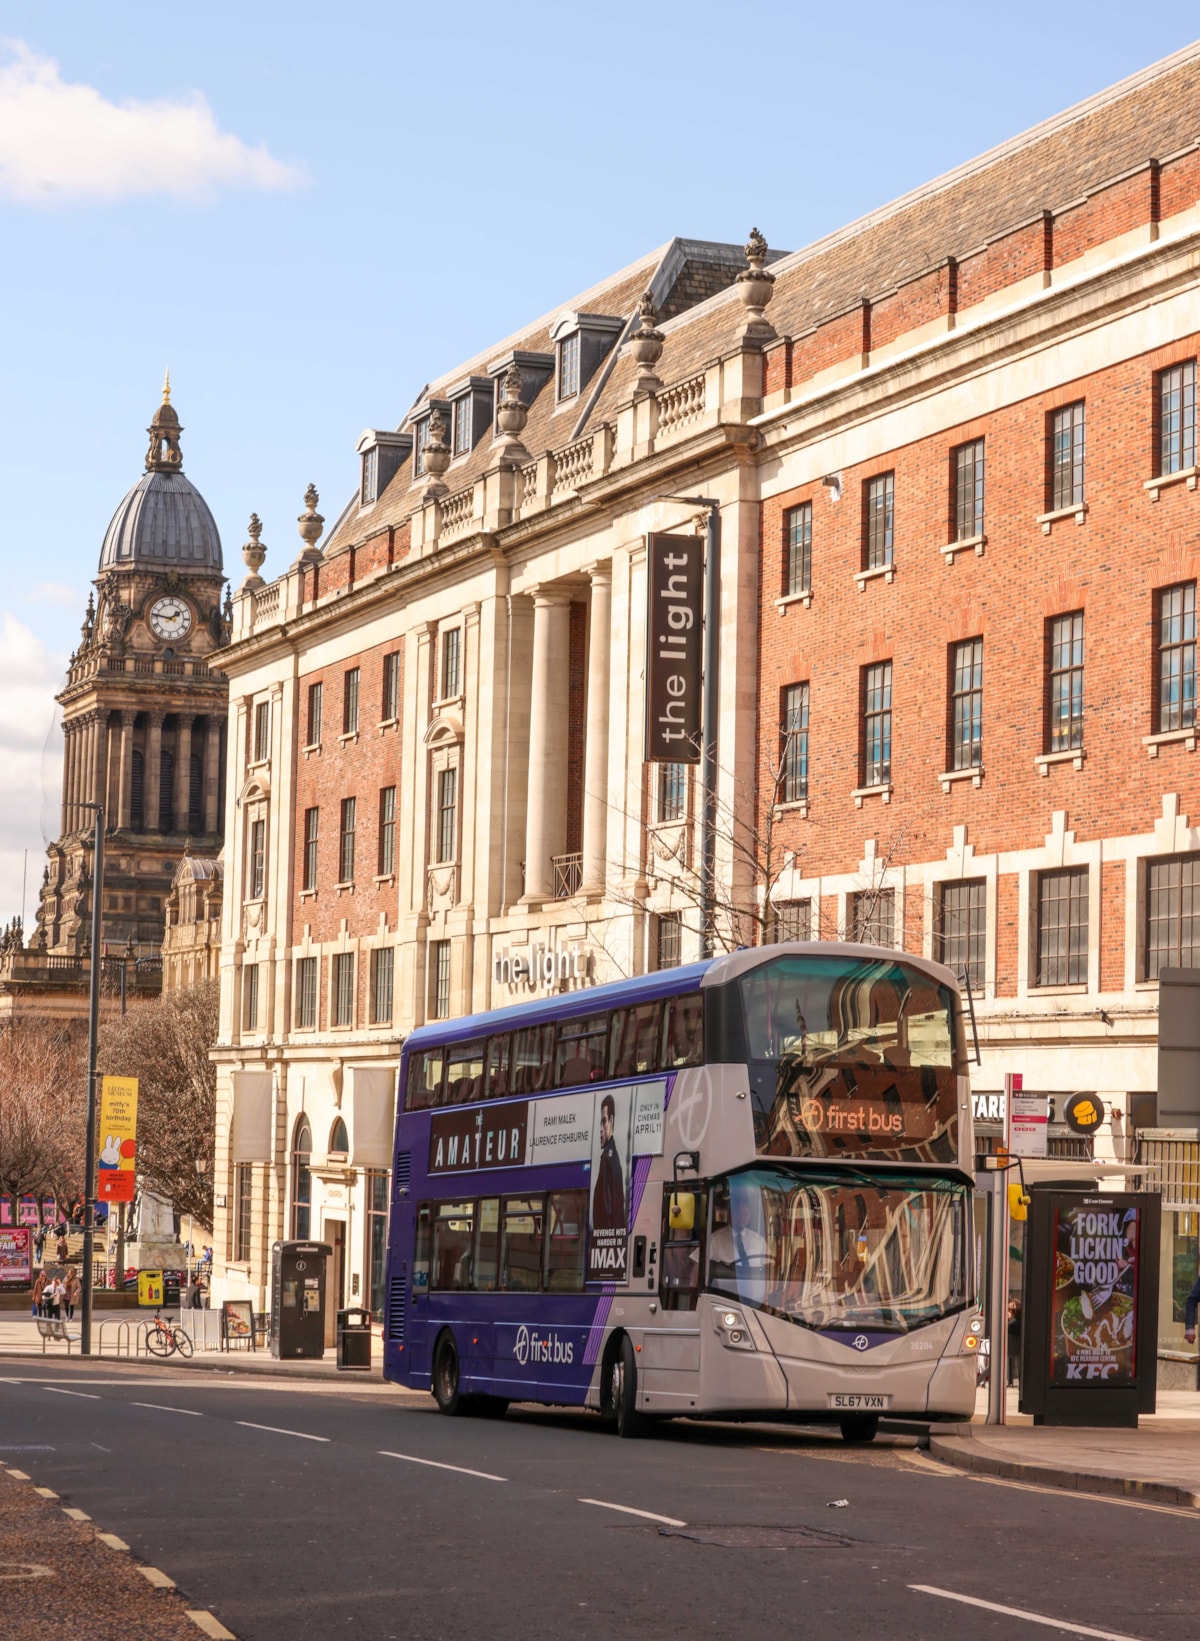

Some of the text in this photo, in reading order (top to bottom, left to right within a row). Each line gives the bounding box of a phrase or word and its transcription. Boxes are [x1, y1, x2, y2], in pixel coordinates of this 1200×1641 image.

[658, 552, 694, 743] the light
[529, 941, 581, 989] light
[640, 1102, 660, 1112] ONLY IN
[105, 1114, 132, 1122] birthday
[543, 1113, 577, 1127] RAMI MALEK
[637, 1112, 660, 1122] CINEMAS
[826, 1105, 902, 1131] first bus
[635, 1123, 662, 1135] APRIL 11
[529, 1130, 589, 1147] LAURENCE FISHBURNE
[435, 1128, 520, 1167] AMATEUR
[593, 1228, 627, 1237] REVENGE HITS
[1077, 1213, 1120, 1236] FORK
[597, 1238, 623, 1246] HARDER IN
[1070, 1237, 1130, 1260] LICKIN'
[590, 1247, 626, 1269] IMAX
[1073, 1261, 1119, 1284] GOOD
[530, 1332, 573, 1364] first bus
[910, 1341, 933, 1350] 35284
[1066, 1363, 1119, 1379] KFC
[835, 1396, 884, 1407] SL67 VXN
